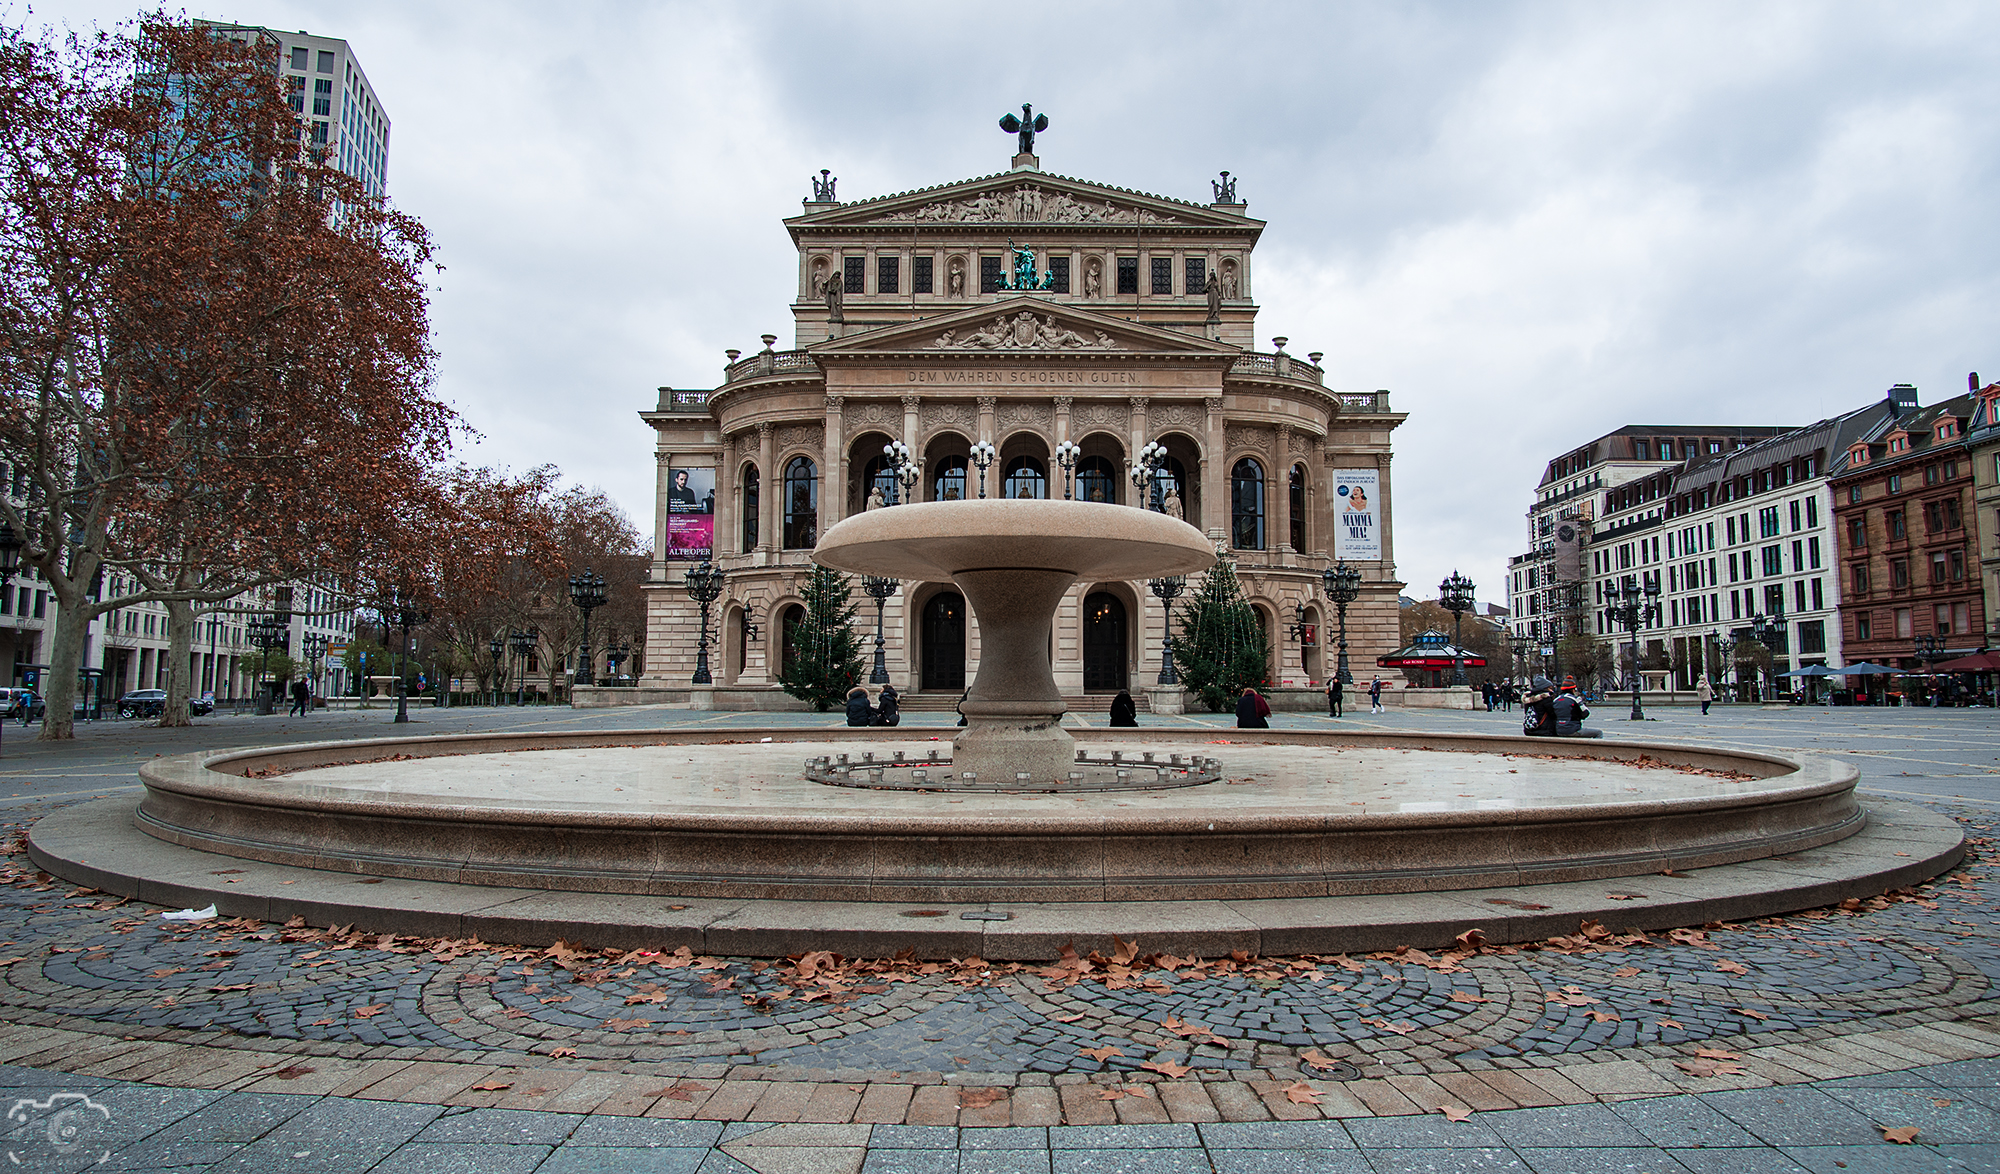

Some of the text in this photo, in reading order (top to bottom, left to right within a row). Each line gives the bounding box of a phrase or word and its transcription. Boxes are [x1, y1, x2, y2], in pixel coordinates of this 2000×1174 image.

[909, 371, 1141, 383] DEM WAHREN SCHOENEN GUTEN.
[1342, 514, 1373, 526] MAMMA
[1349, 527, 1367, 538] MIA!
